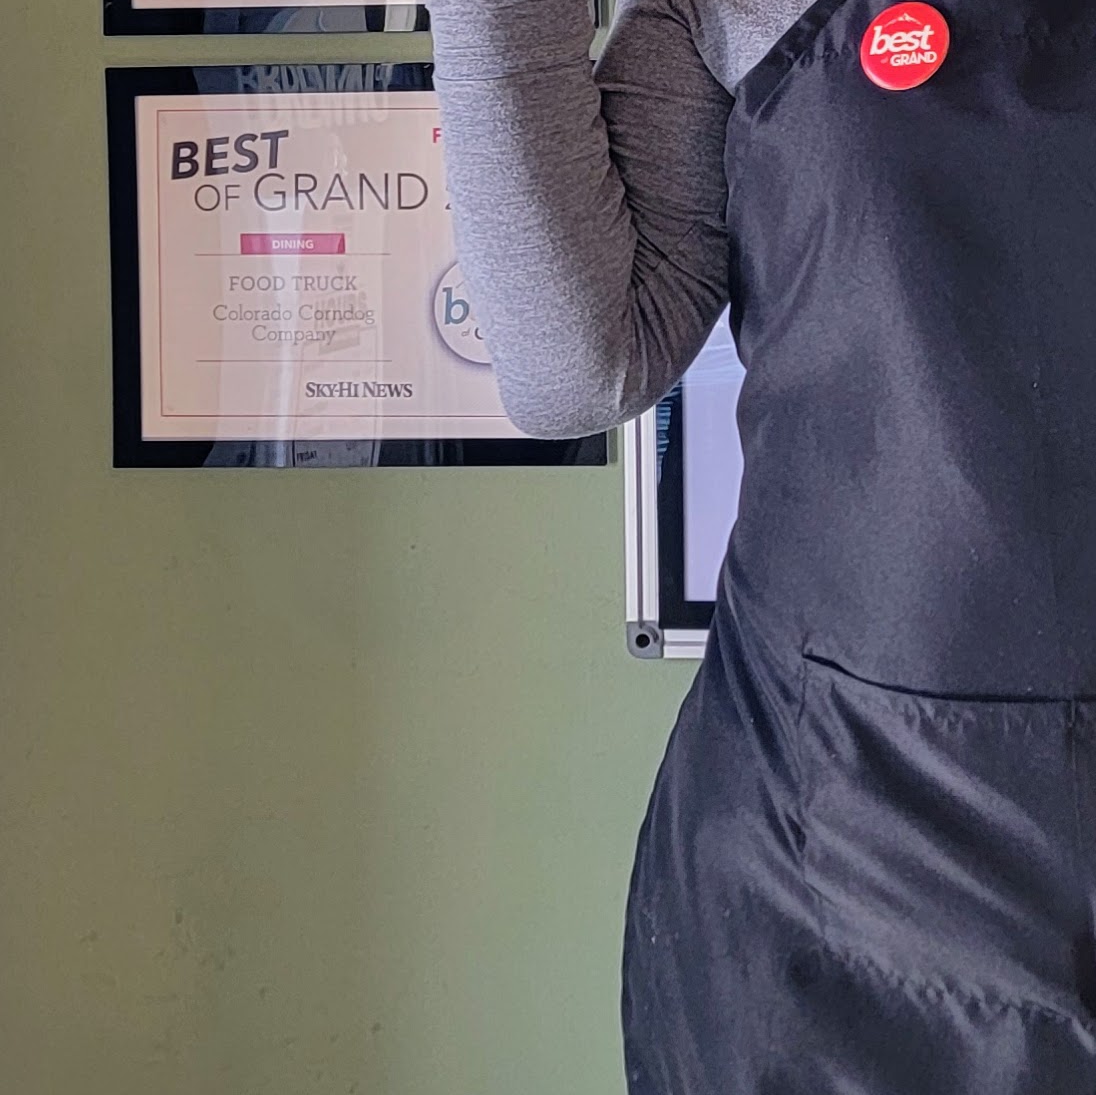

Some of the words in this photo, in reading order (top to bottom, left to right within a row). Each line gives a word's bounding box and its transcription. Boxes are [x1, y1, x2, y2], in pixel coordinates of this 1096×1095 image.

[870, 25, 934, 55] best
[890, 51, 937, 66] GRAND
[171, 130, 288, 180] BEST
[195, 184, 240, 211] OF
[254, 173, 429, 210] GRAND
[272, 239, 313, 250] DINING
[229, 276, 285, 292] FOOD
[292, 276, 357, 292] TRUCK
[213, 305, 292, 323] Colorado
[298, 305, 375, 325] Corndog
[252, 325, 336, 347] Company
[362, 382, 413, 398] NEWS
